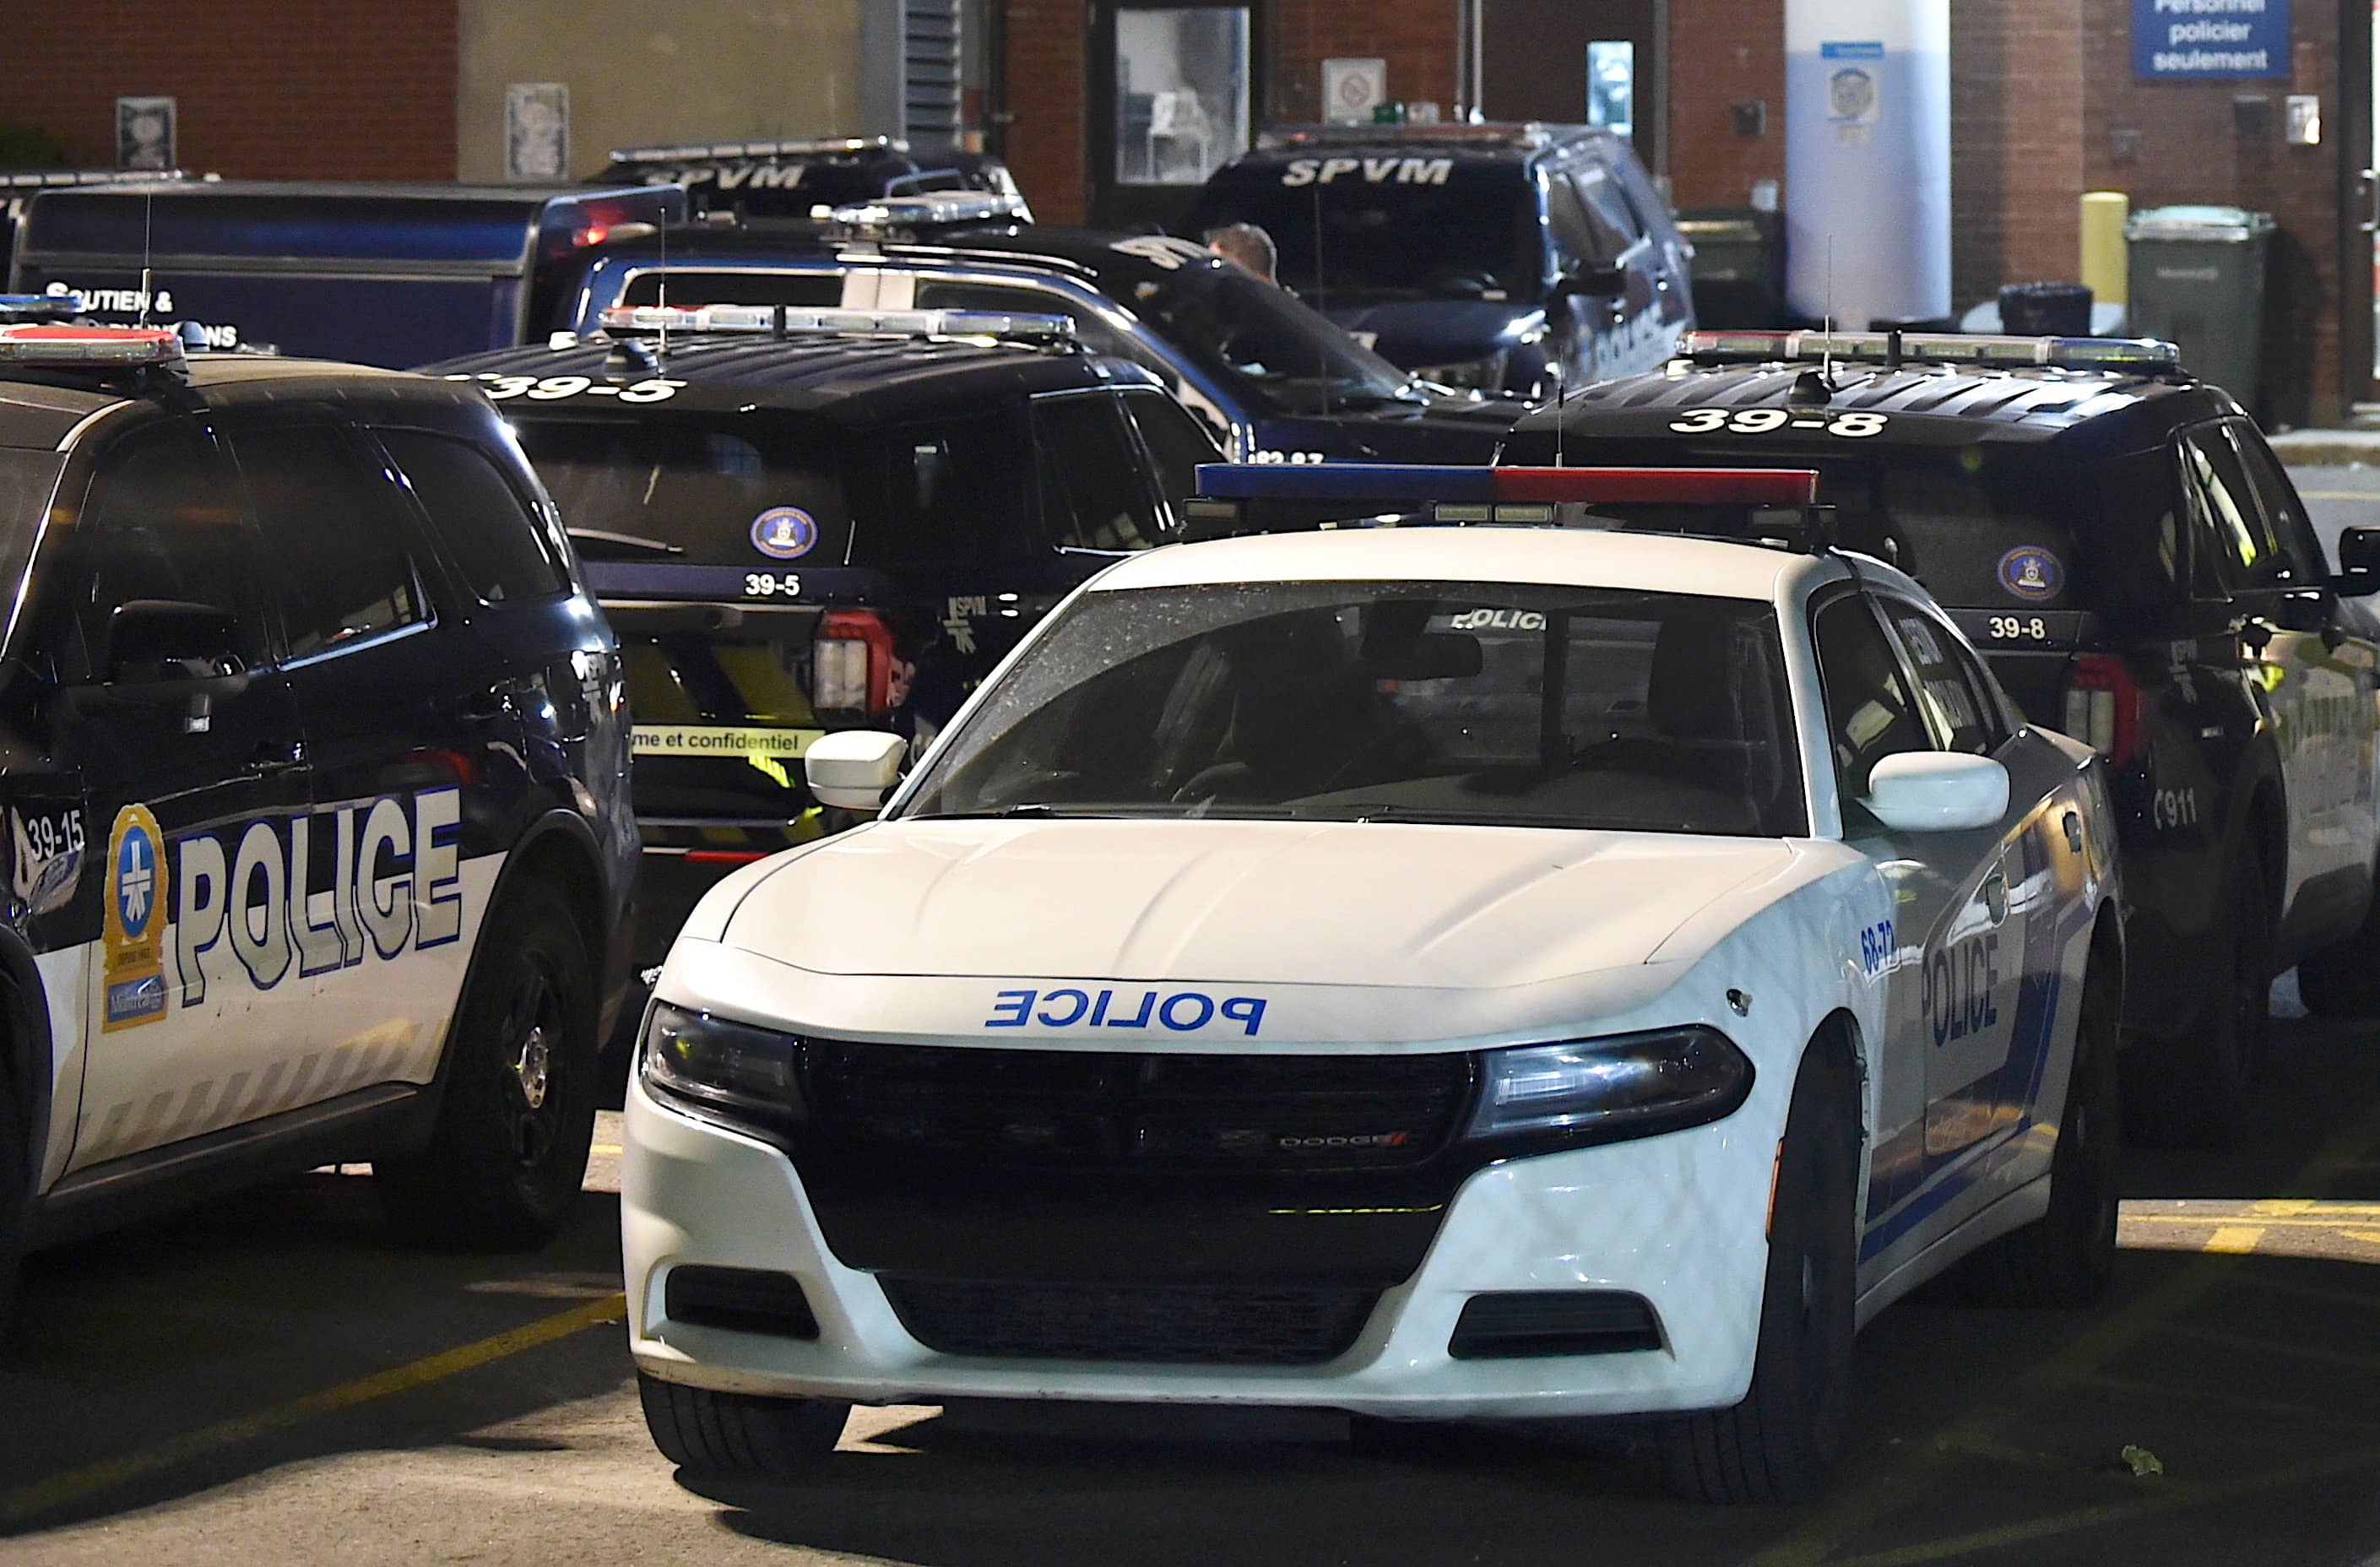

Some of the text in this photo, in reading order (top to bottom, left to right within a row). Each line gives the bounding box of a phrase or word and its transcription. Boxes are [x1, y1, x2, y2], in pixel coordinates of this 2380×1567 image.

[2169, 20, 2252, 46] policier
[2153, 49, 2269, 70] seulement
[1282, 157, 1453, 187] SPVM
[155, 291, 173, 312] &
[484, 376, 688, 403] 39-5
[1669, 409, 1889, 437] 39-8
[745, 573, 800, 596] 39-5
[1989, 616, 2046, 639] 39-8
[666, 732, 682, 748] et
[688, 734, 799, 751] confidentiel
[2165, 787, 2197, 827] 911
[28, 809, 85, 861] 39-15
[176, 784, 462, 1008] POLICE
[1860, 919, 1896, 975] 68-72
[1922, 933, 2000, 1048] POLICE
